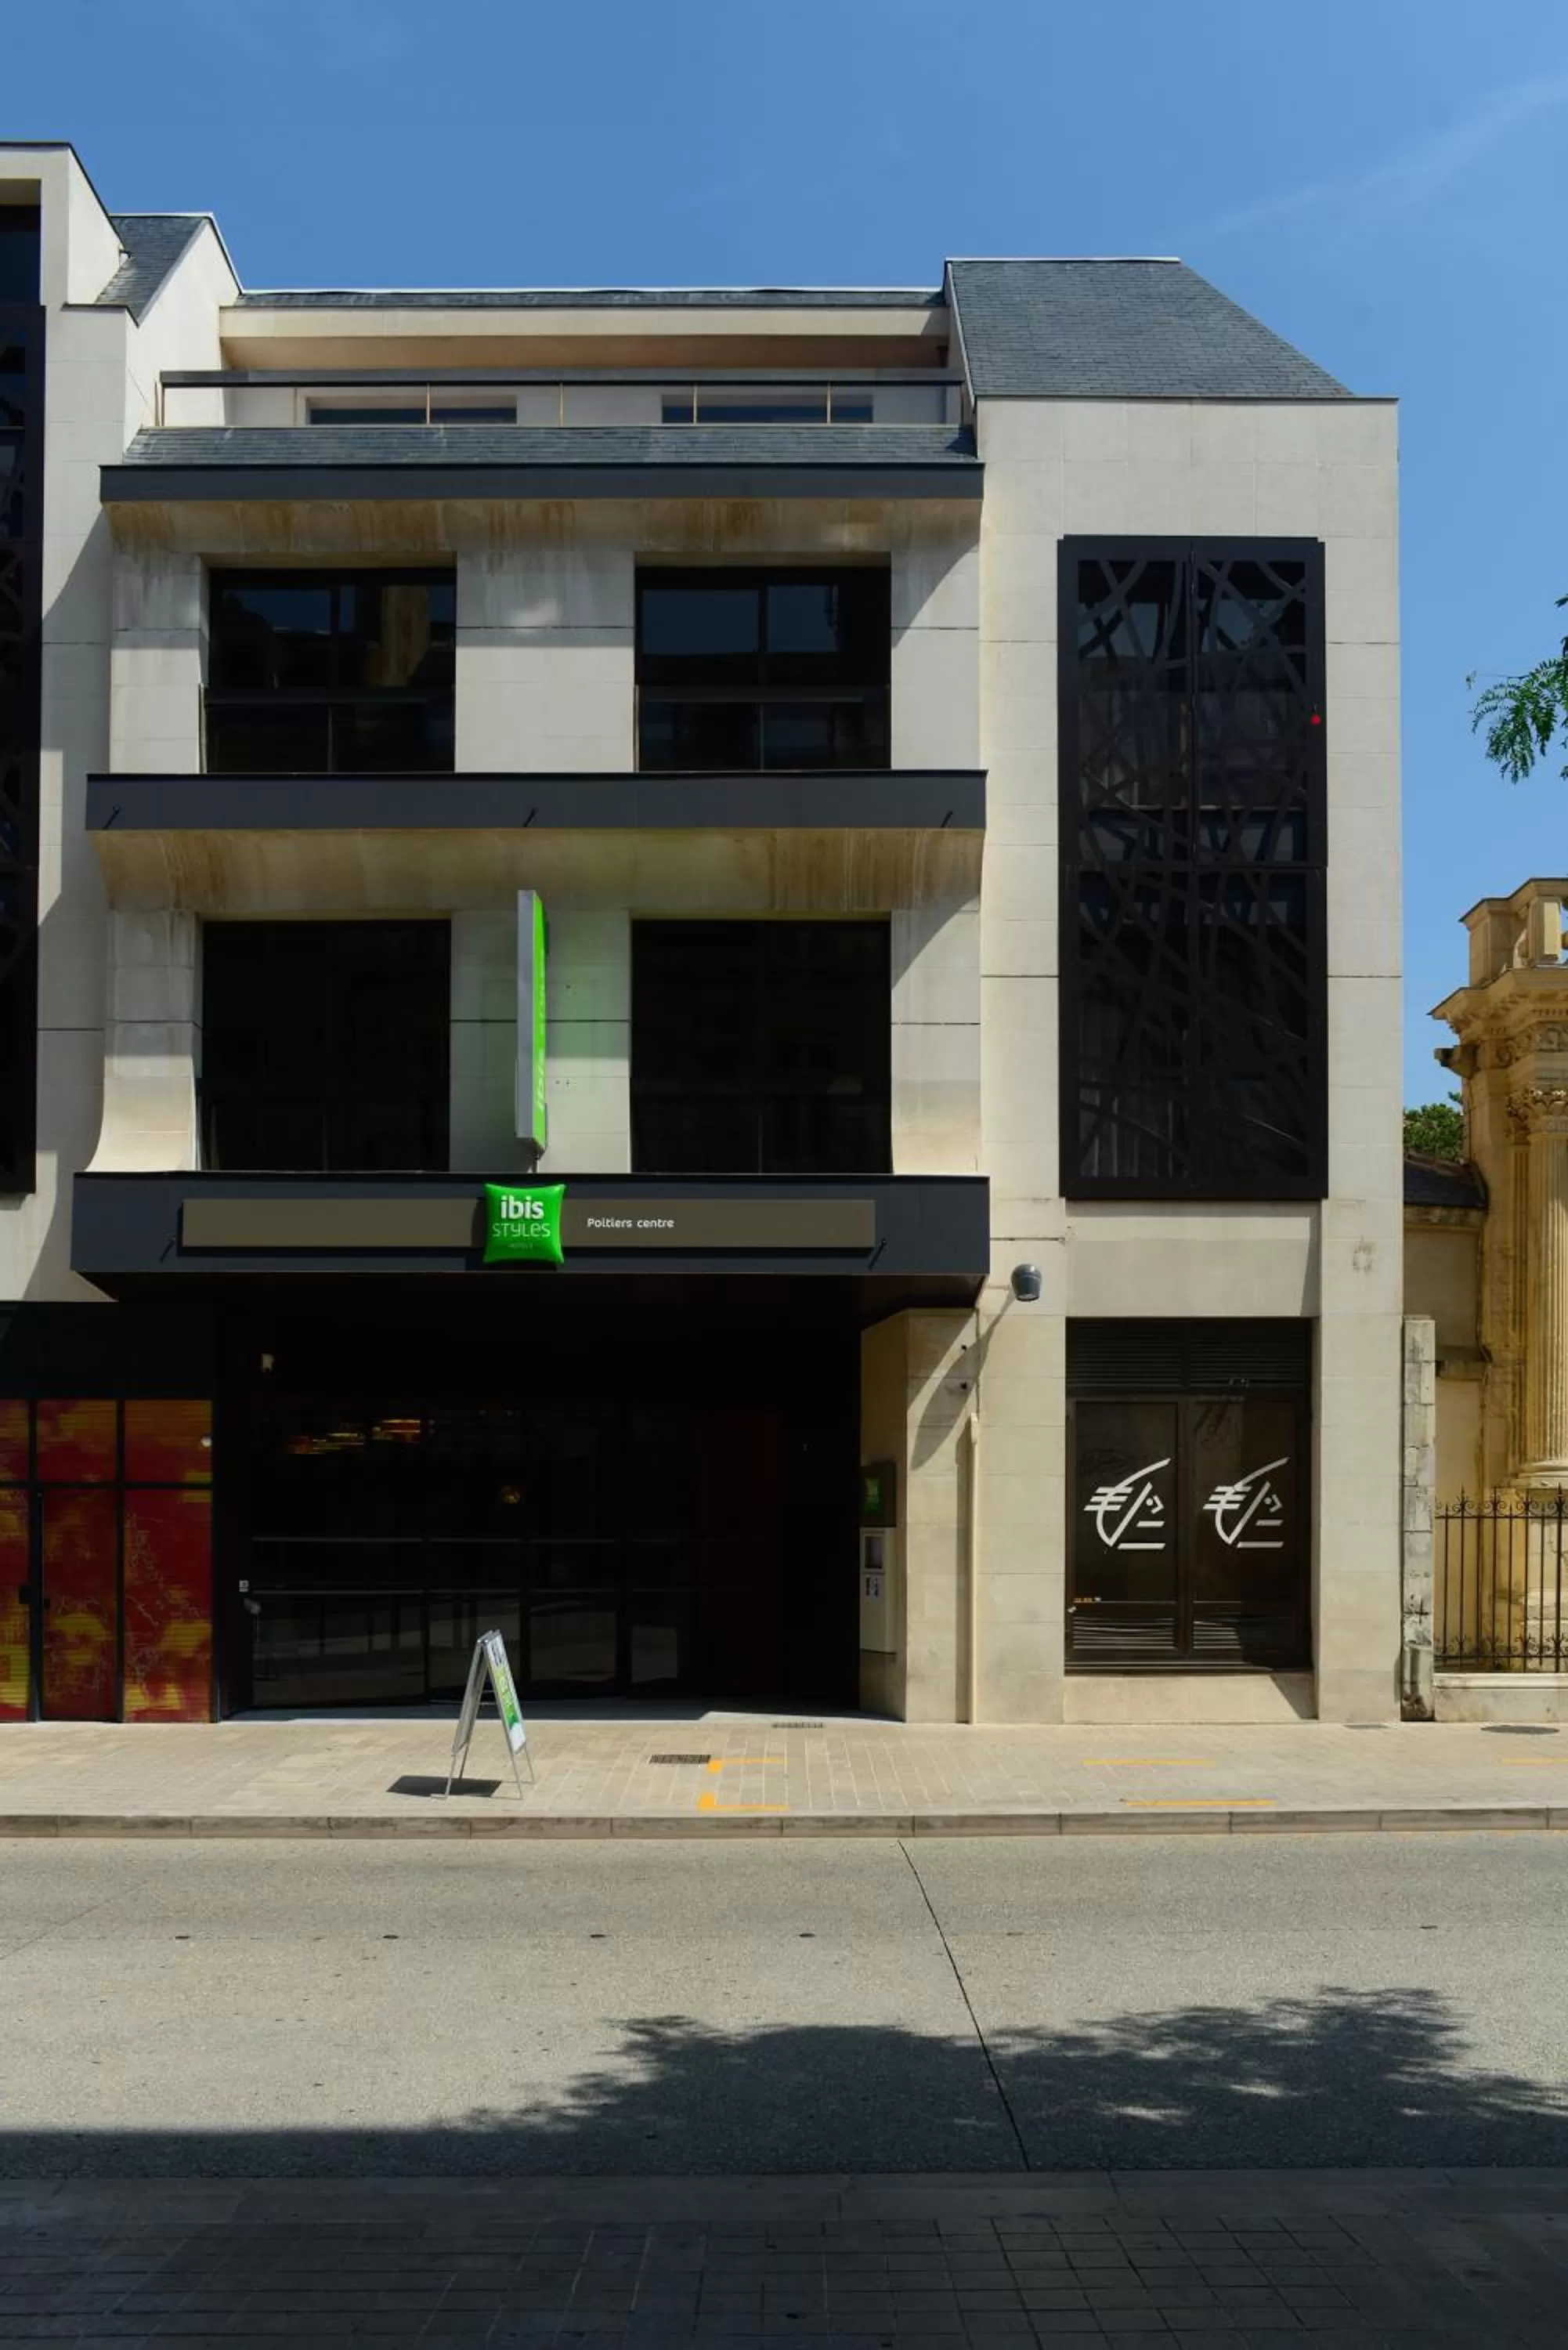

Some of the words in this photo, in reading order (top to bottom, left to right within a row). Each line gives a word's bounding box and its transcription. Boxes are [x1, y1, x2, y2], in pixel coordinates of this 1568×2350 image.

[500, 1195, 544, 1220] ibis
[587, 1217, 633, 1228] Poitiers
[637, 1218, 674, 1228] centre
